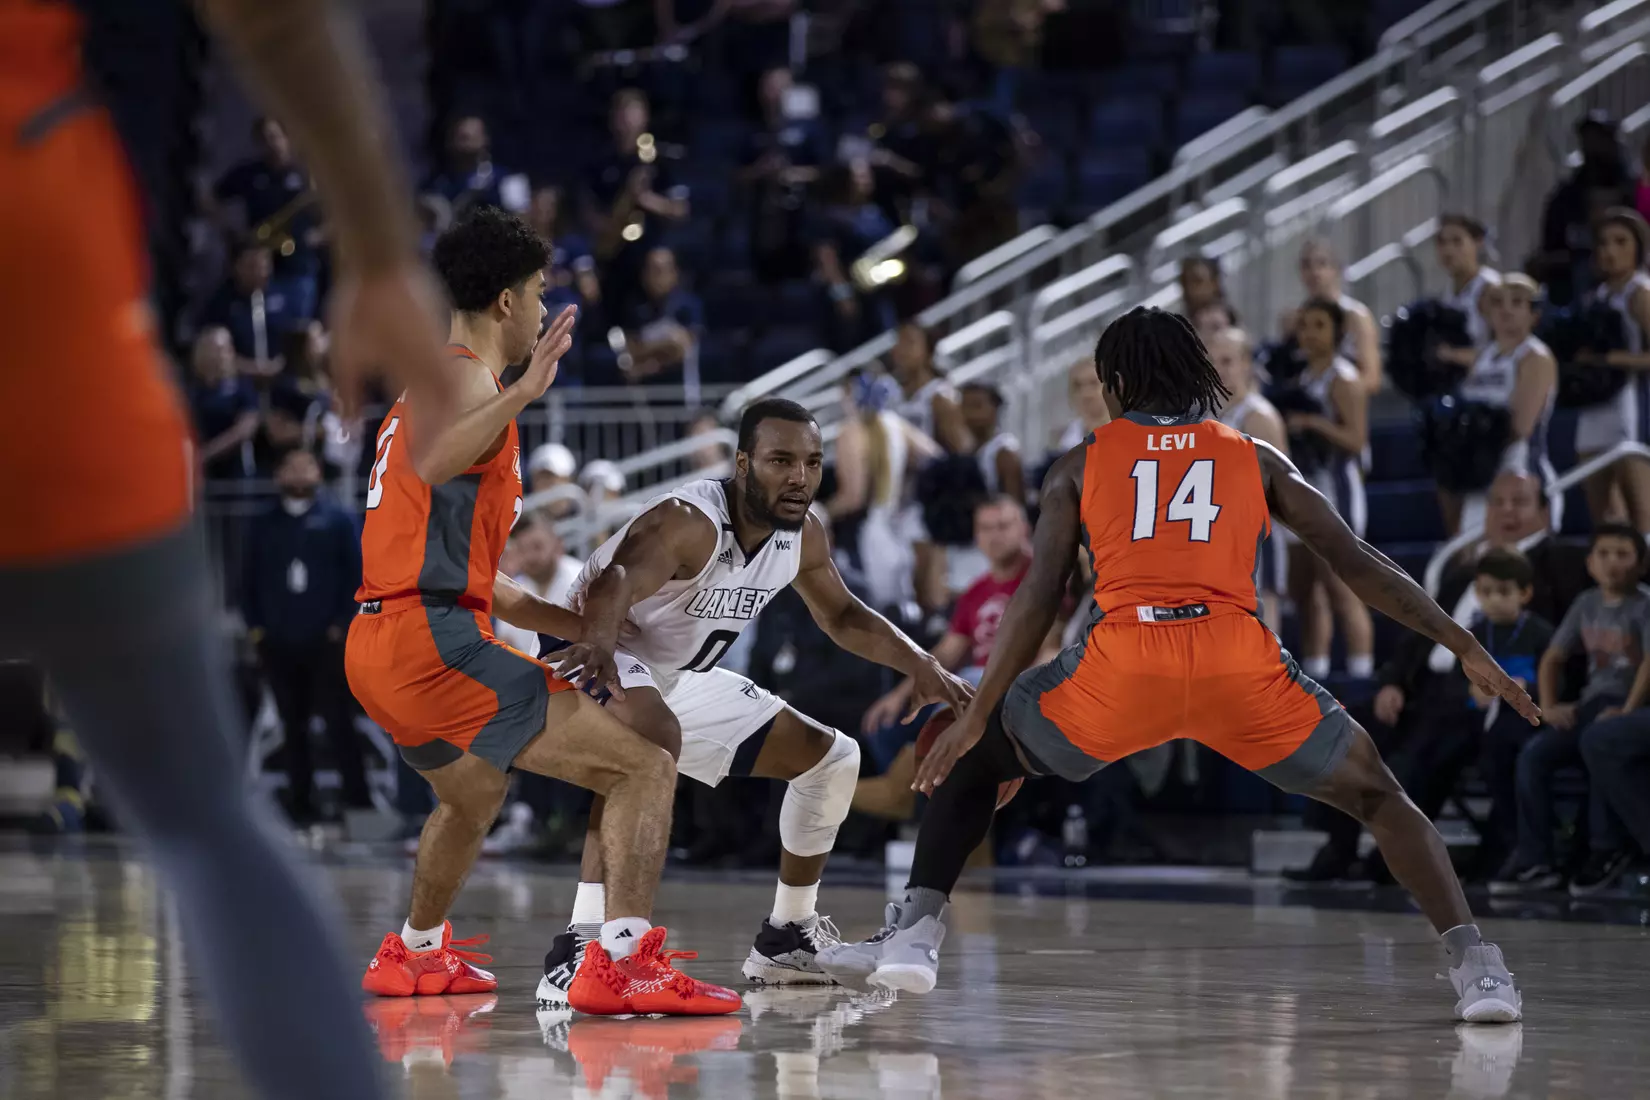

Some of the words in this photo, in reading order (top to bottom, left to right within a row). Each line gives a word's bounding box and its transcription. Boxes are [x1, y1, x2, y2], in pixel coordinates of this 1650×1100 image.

[1146, 432, 1195, 451] LEVI
[1129, 458, 1222, 543] 14
[775, 540, 793, 551] WA
[676, 629, 740, 673] 0
